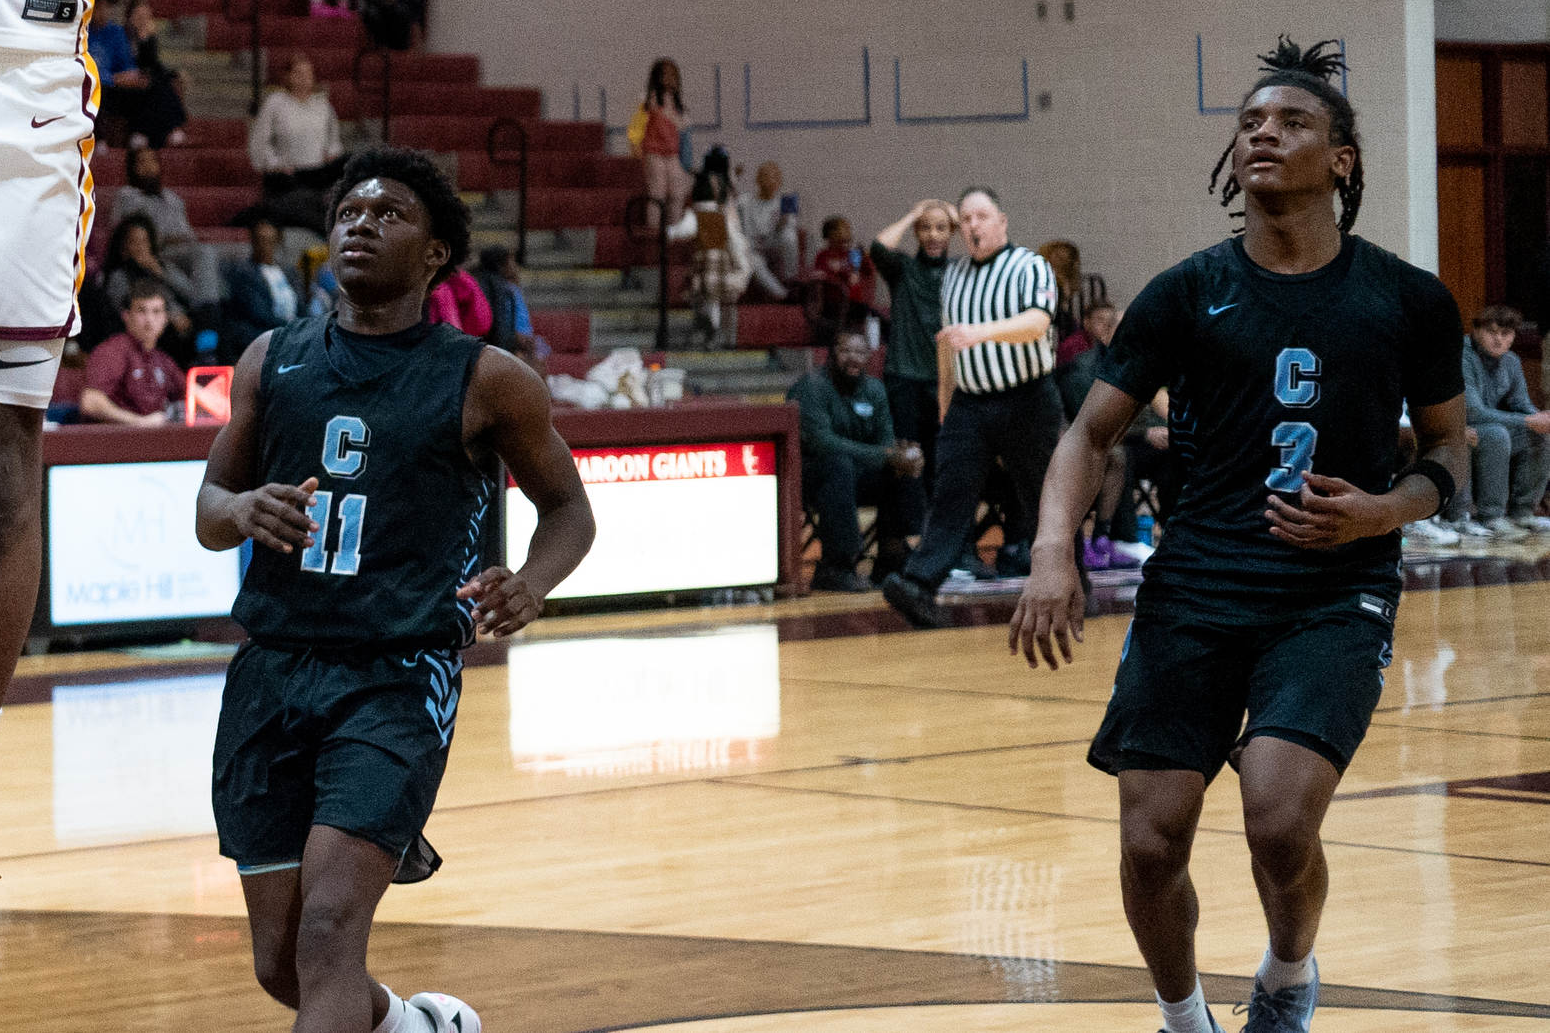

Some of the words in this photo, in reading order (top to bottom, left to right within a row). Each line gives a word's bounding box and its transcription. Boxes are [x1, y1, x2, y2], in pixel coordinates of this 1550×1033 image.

[61, 7, 71, 18] S
[1274, 348, 1322, 408] C
[321, 415, 372, 480] C
[574, 454, 649, 482] AROON
[652, 450, 727, 479] GIANTS
[1264, 421, 1319, 493] 3
[301, 490, 367, 576] 11
[66, 575, 141, 608] Maple
[145, 571, 174, 600] Hill
